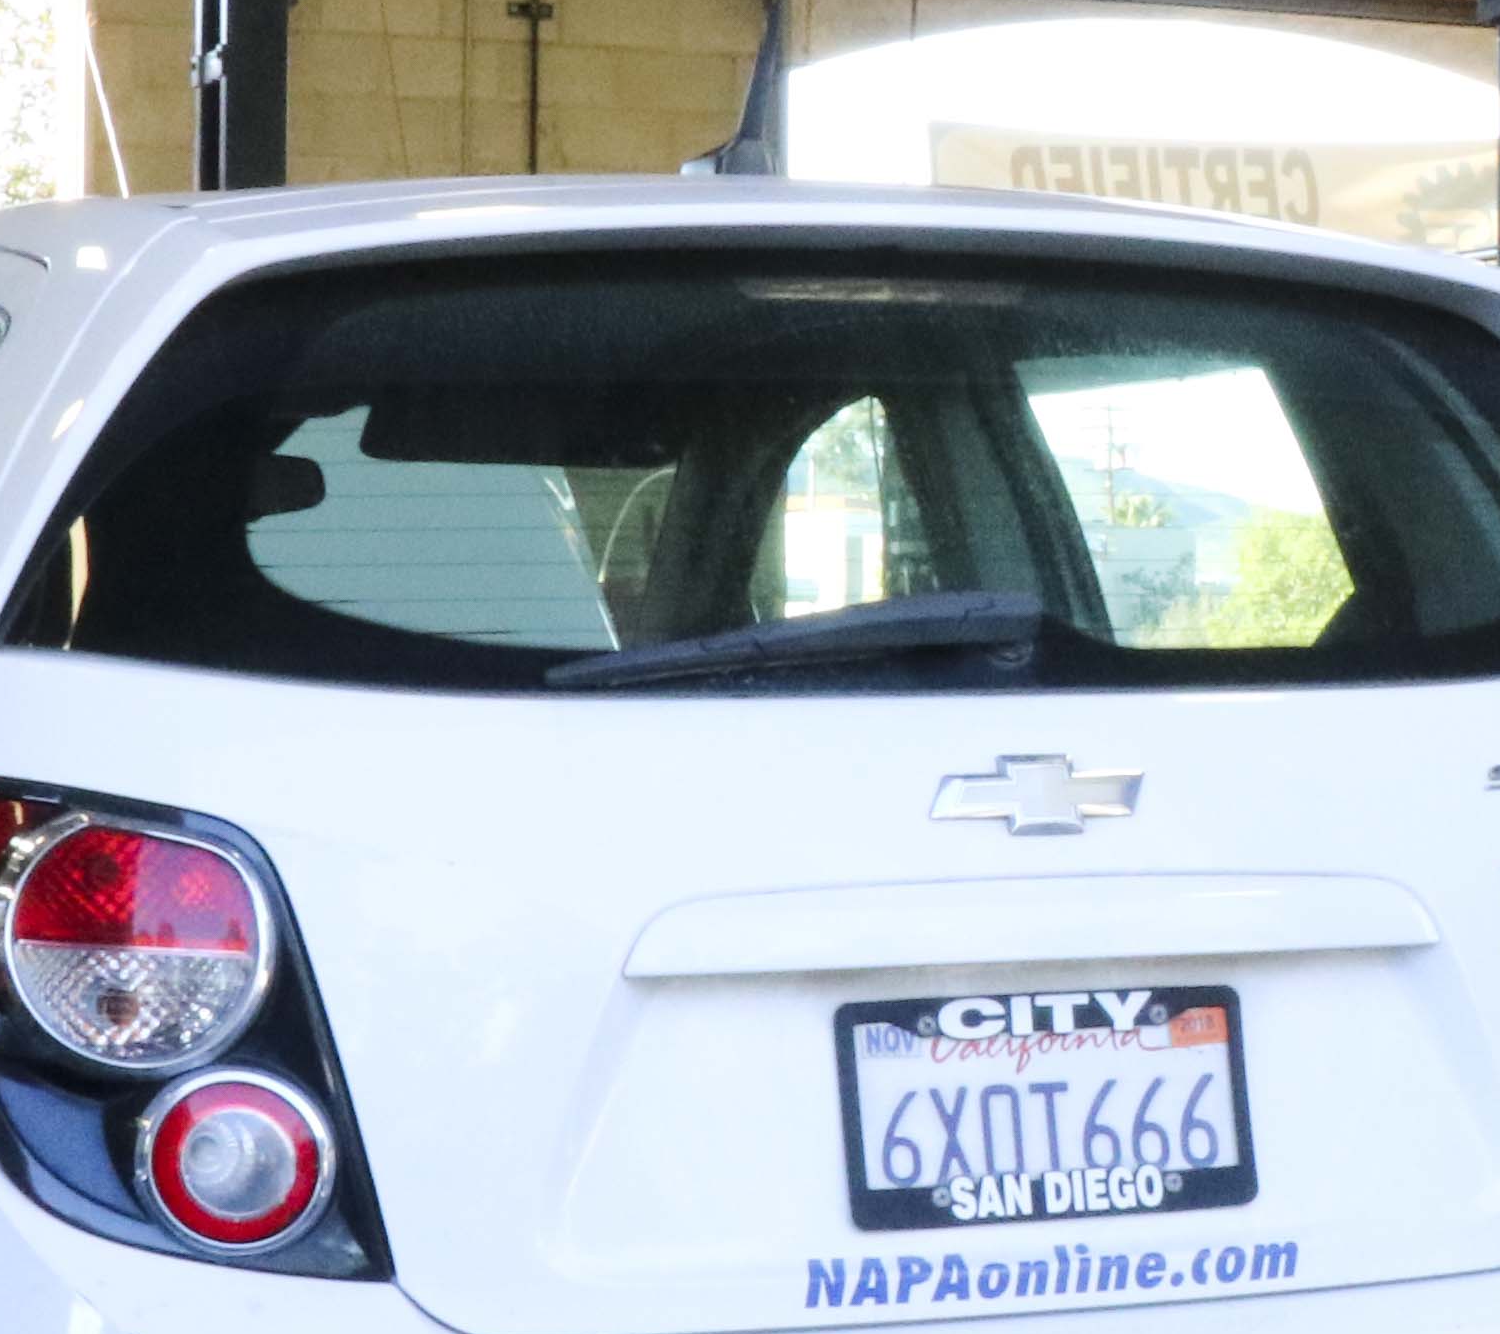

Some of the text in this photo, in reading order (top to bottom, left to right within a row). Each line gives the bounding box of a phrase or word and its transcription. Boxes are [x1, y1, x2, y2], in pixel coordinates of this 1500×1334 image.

[865, 1024, 915, 1055] NOV
[937, 989, 1153, 1043] CITY
[949, 1163, 1166, 1221] SAN DIEGO
[804, 1238, 1300, 1310] NAPAonline.com
